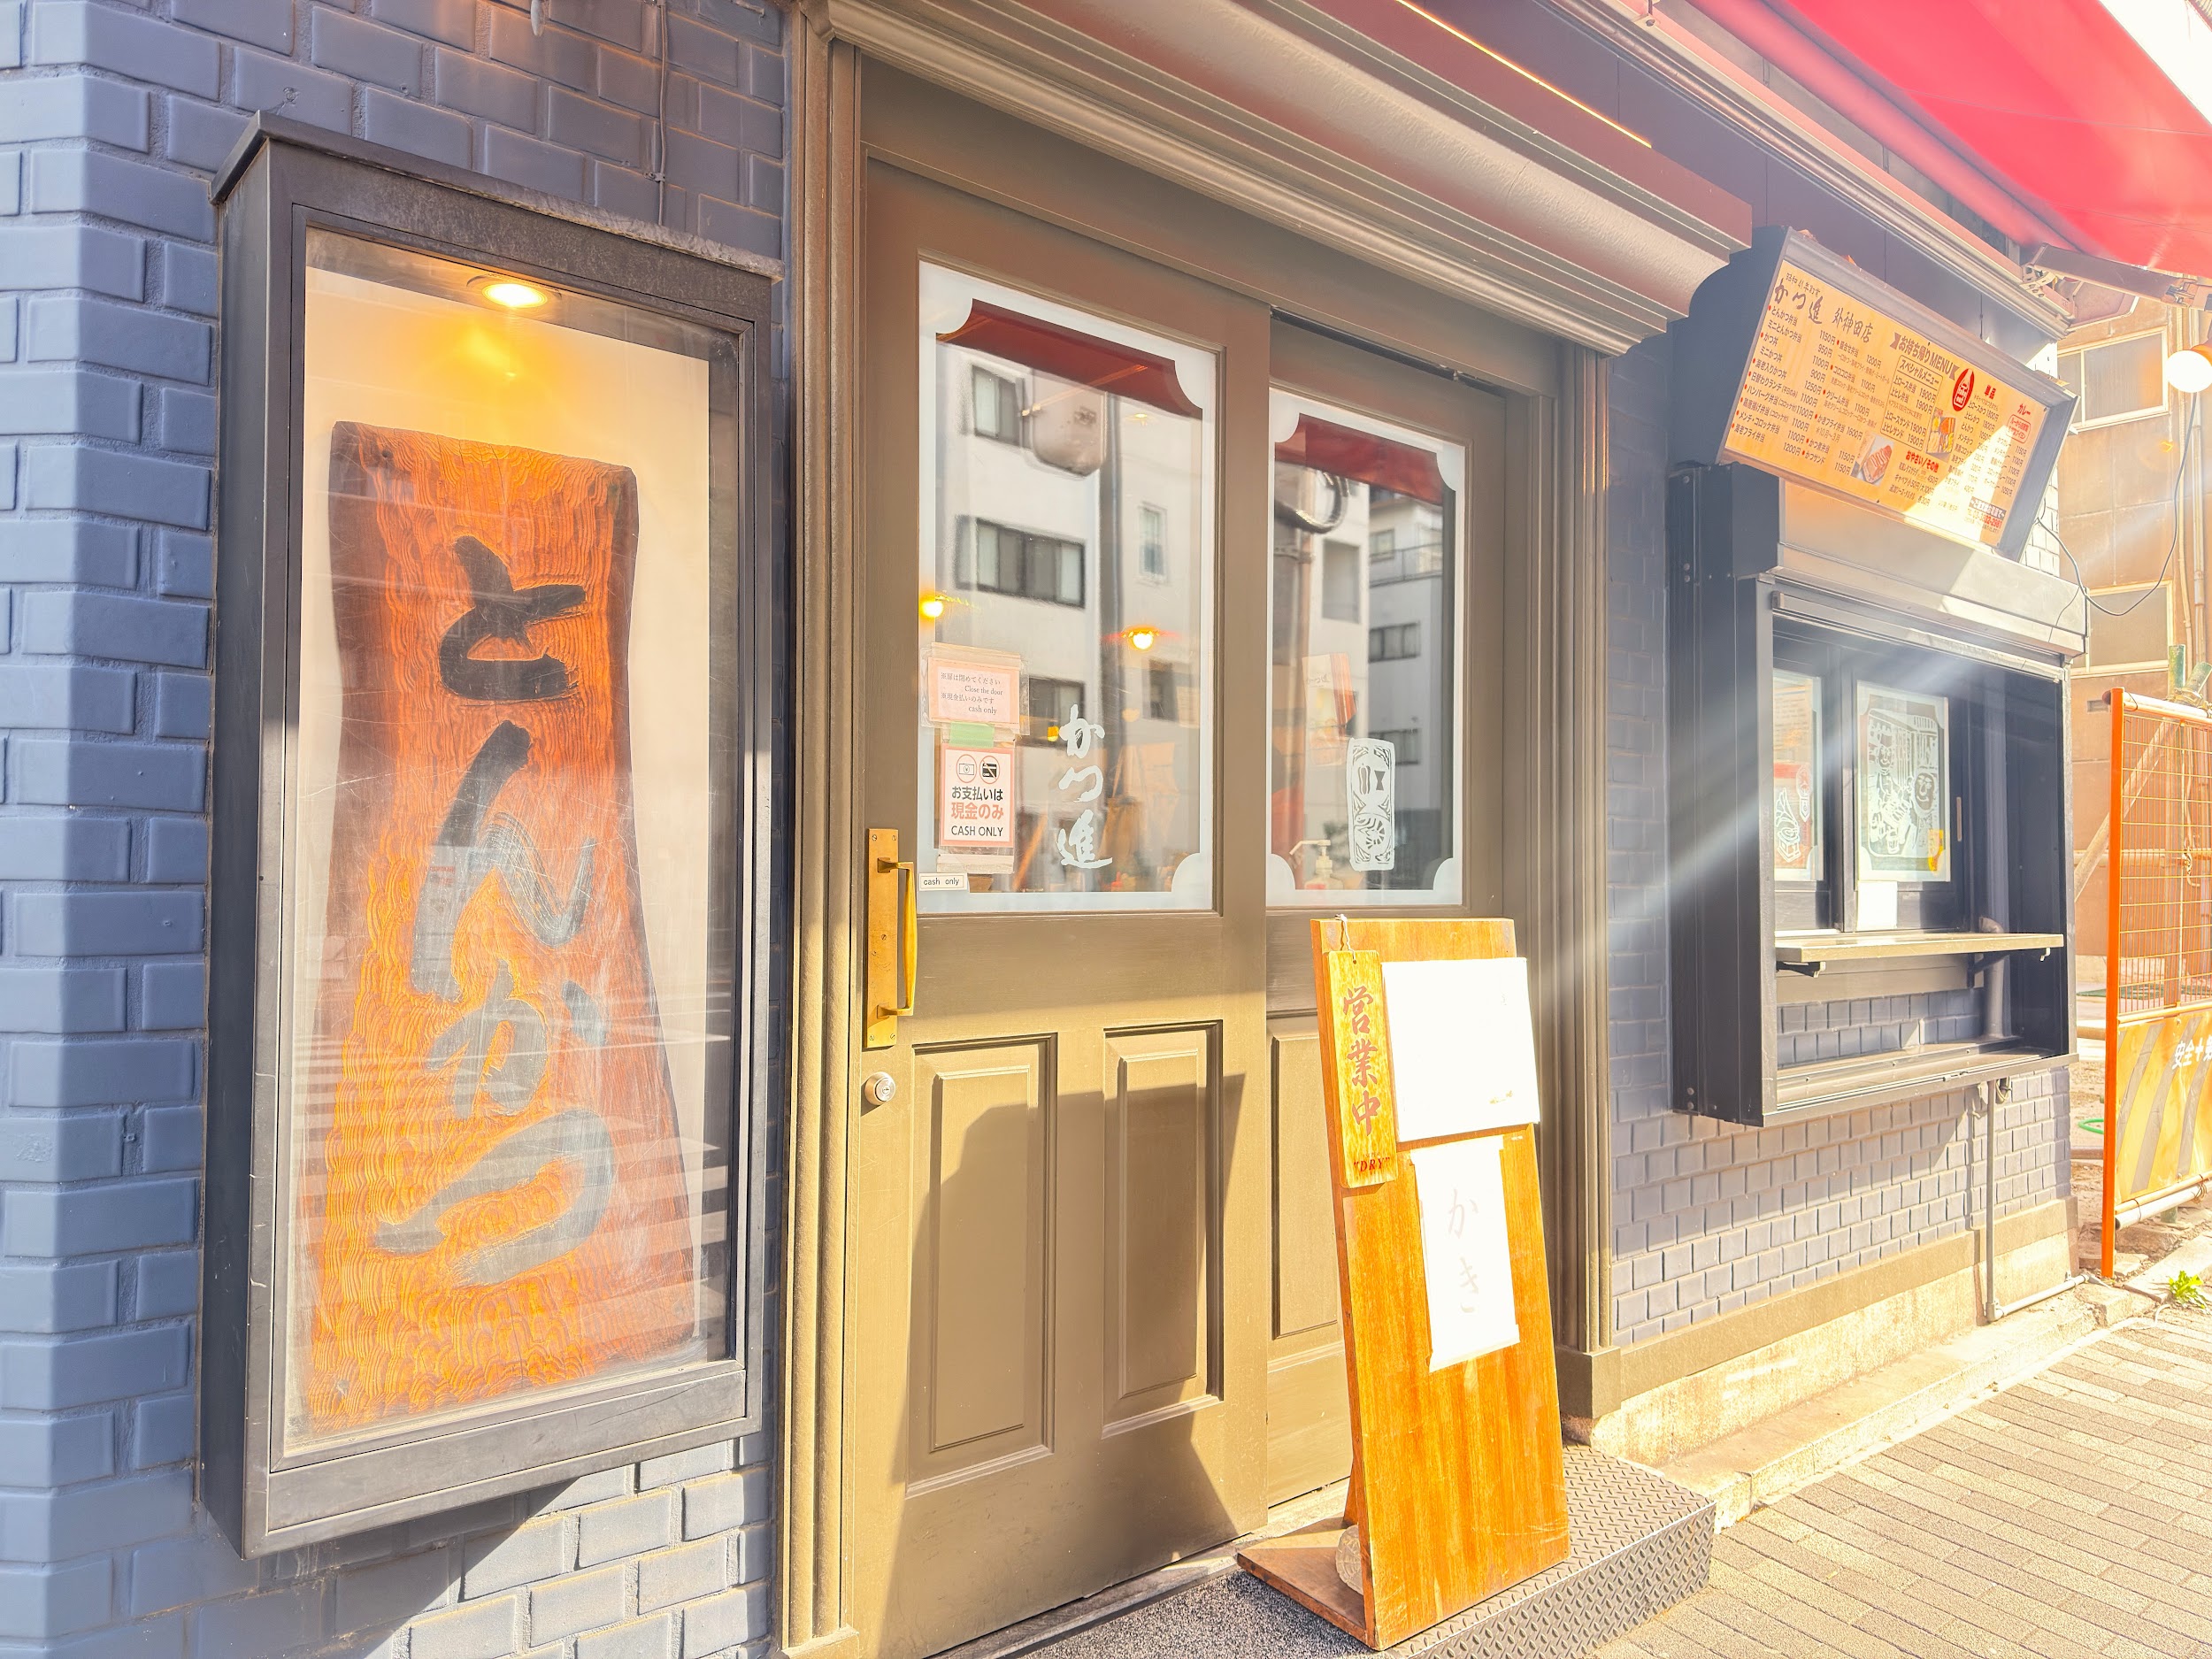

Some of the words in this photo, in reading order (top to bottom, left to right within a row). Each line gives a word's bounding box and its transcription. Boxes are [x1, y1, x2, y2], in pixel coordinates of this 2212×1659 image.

[1774, 277, 1824, 325] かつ進
[1832, 307, 1873, 343] 外神田店
[1771, 305, 1798, 326] とんかつ弁当
[1819, 329, 1836, 345] 1150円
[1767, 319, 1802, 343] ミニとんかつ弁当
[1817, 343, 1833, 358] 950円
[1763, 332, 1778, 347] かつ丼
[1812, 355, 1830, 371] 1100円
[1760, 345, 1783, 363] ミニかつ丼
[1809, 368, 1826, 383] 900円
[1899, 359, 1939, 385] スペシャルメニュー
[1755, 358, 1787, 380] 海老入りかつ丼
[1804, 380, 1822, 396] 1250円
[1861, 379, 1876, 393] 1100円
[1893, 375, 1917, 394] 上ロース弁当
[1919, 388, 1937, 403] 1900円
[1800, 392, 1818, 408] 1100円
[1916, 399, 1933, 415] 1900円
[1796, 405, 1814, 420] 1100円
[1855, 403, 1870, 417] 1100円
[2016, 403, 2031, 416] カレー
[1792, 418, 1809, 432] 1100円
[1817, 415, 1846, 434] かきフライ弁当
[1885, 410, 1911, 428] 上ロースサンド
[1733, 423, 1766, 443] 海老フライ弁当
[1783, 442, 1801, 457] 1200円
[1787, 429, 1806, 444] 1100円
[1907, 433, 1924, 449] 1900円
[1804, 451, 1826, 465] かつサンド
[1834, 462, 1851, 475] 1150円
[1838, 449, 1855, 464] 1150円
[983, 706, 997, 715] only
[951, 786, 1003, 801] お支払いは
[1056, 704, 1113, 869] かつ進
[951, 803, 1003, 820] 現金のみ
[951, 826, 976, 836] CASH
[978, 826, 1003, 837] ONLY
[945, 877, 960, 887] only
[373, 535, 616, 1286] とんかつ
[1342, 986, 1381, 1136] 営業中
[1448, 1187, 1479, 1314] かき
